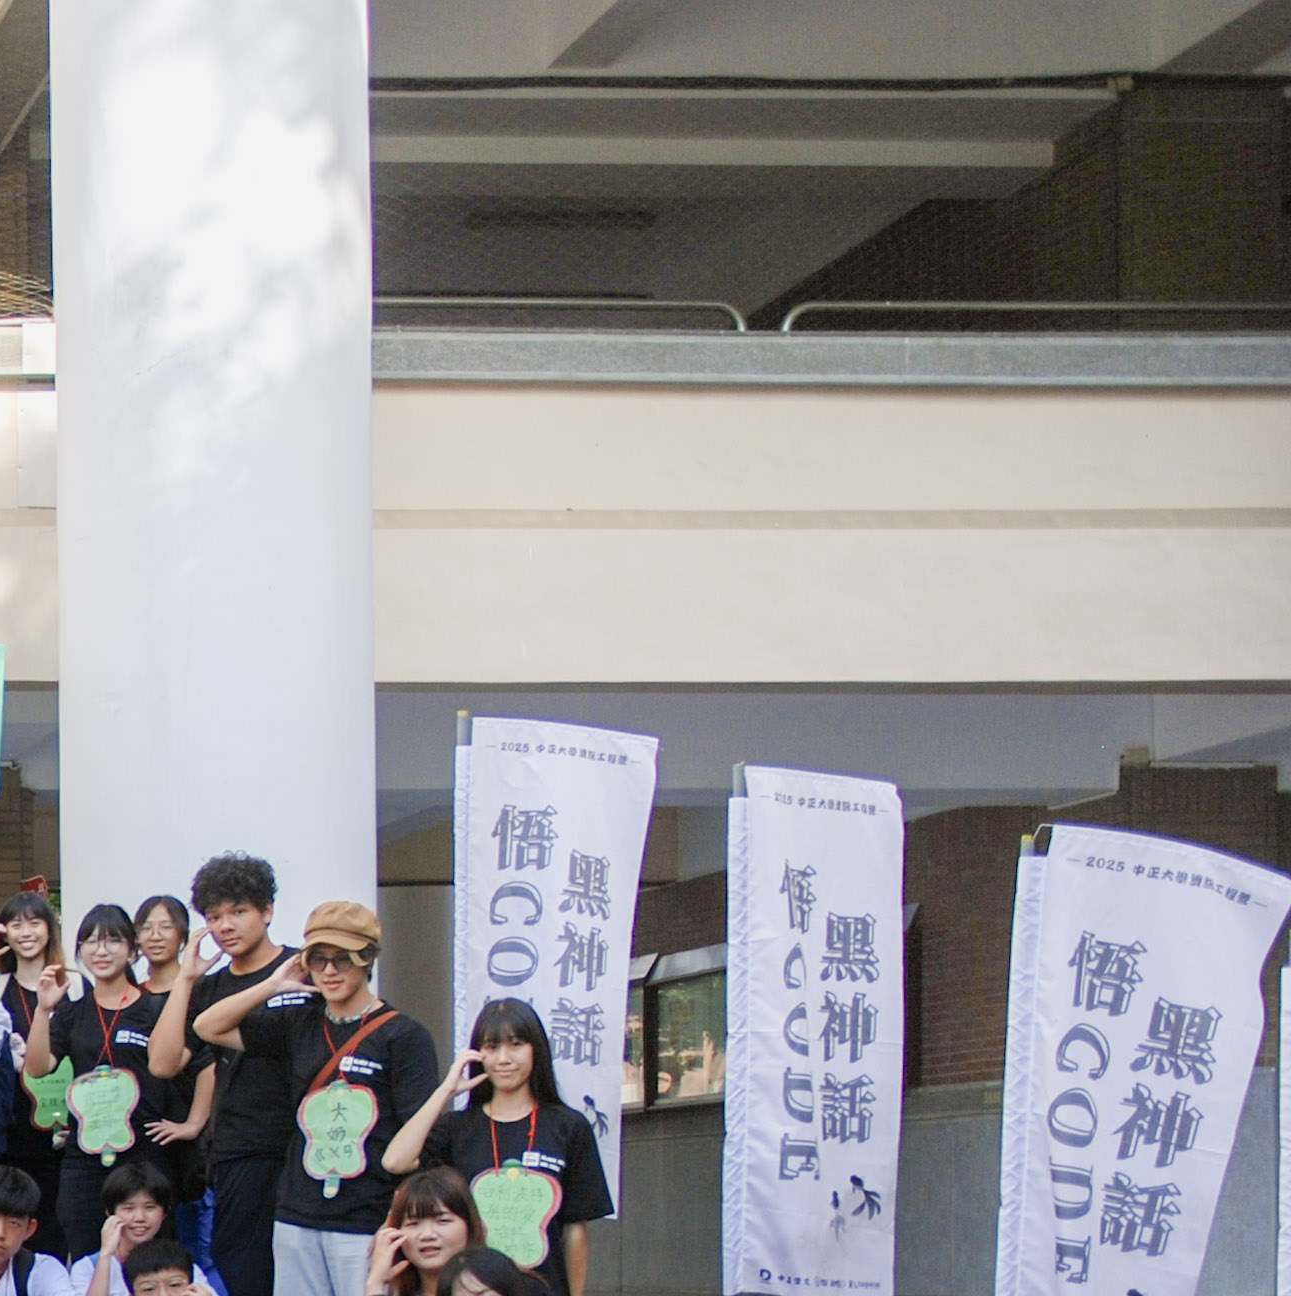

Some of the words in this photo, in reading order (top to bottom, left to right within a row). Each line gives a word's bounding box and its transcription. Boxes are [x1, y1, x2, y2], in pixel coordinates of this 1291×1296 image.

[500, 742, 530, 754] 2025
[483, 803, 559, 1000] 悟CO
[549, 849, 612, 1068] 黑神話
[1086, 855, 1125, 873] 2025
[819, 912, 880, 1144] 黑神話
[1100, 996, 1223, 1257] 黑神話
